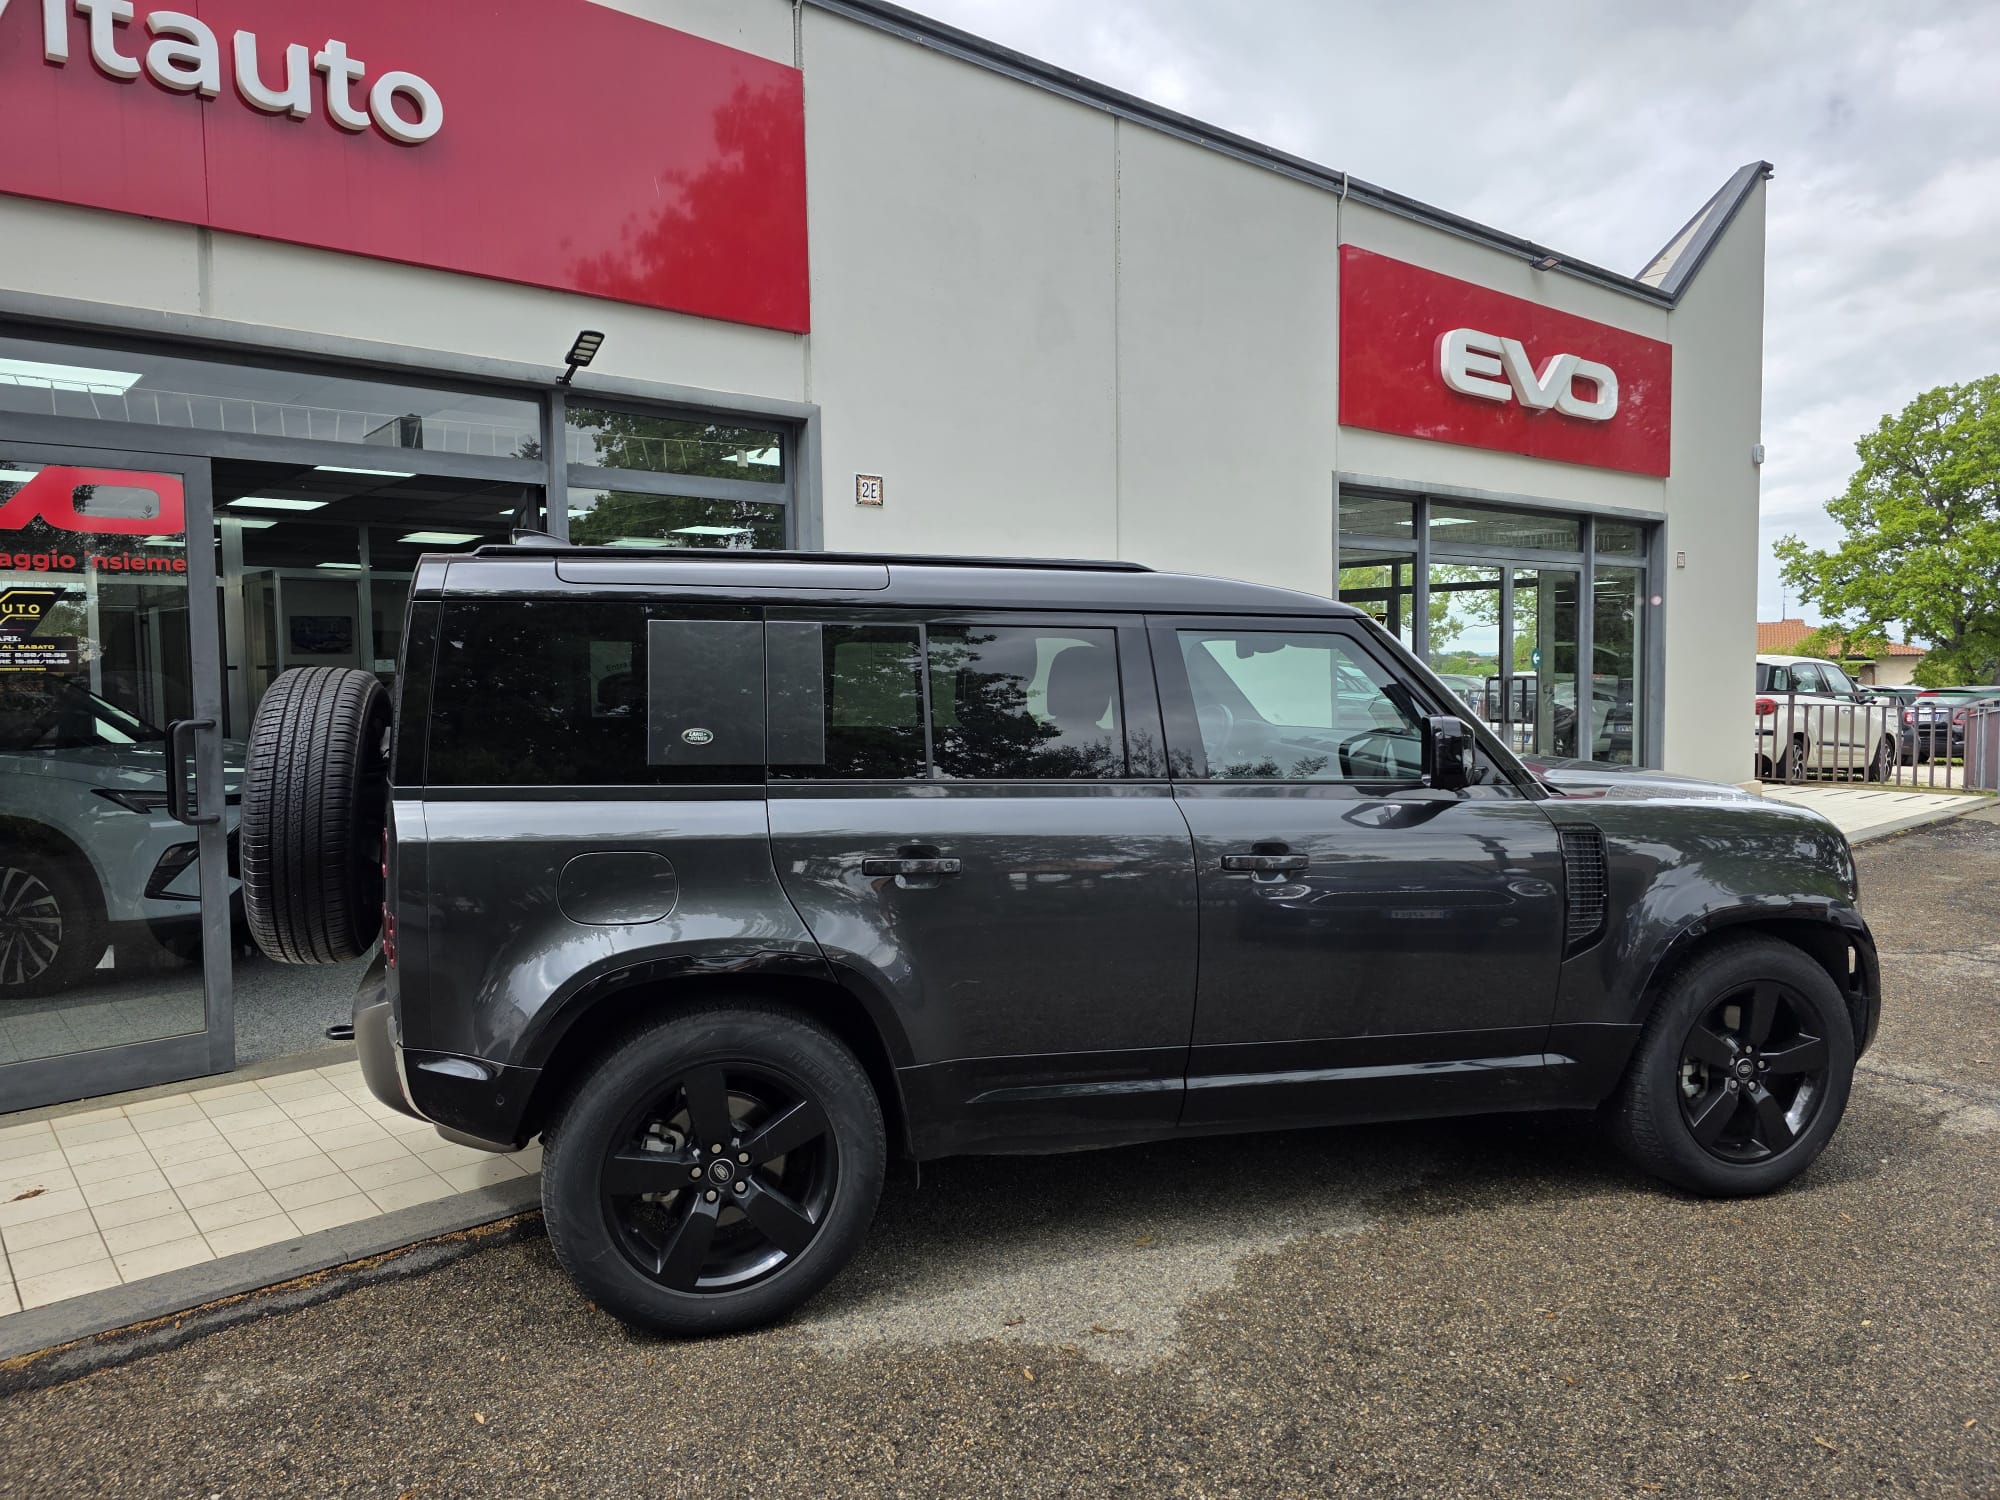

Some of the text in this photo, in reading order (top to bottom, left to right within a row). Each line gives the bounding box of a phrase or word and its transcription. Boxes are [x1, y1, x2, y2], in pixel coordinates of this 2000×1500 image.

[0, 0, 444, 143] itauto
[1439, 327, 1619, 421] EVO
[862, 481, 877, 499] 2E
